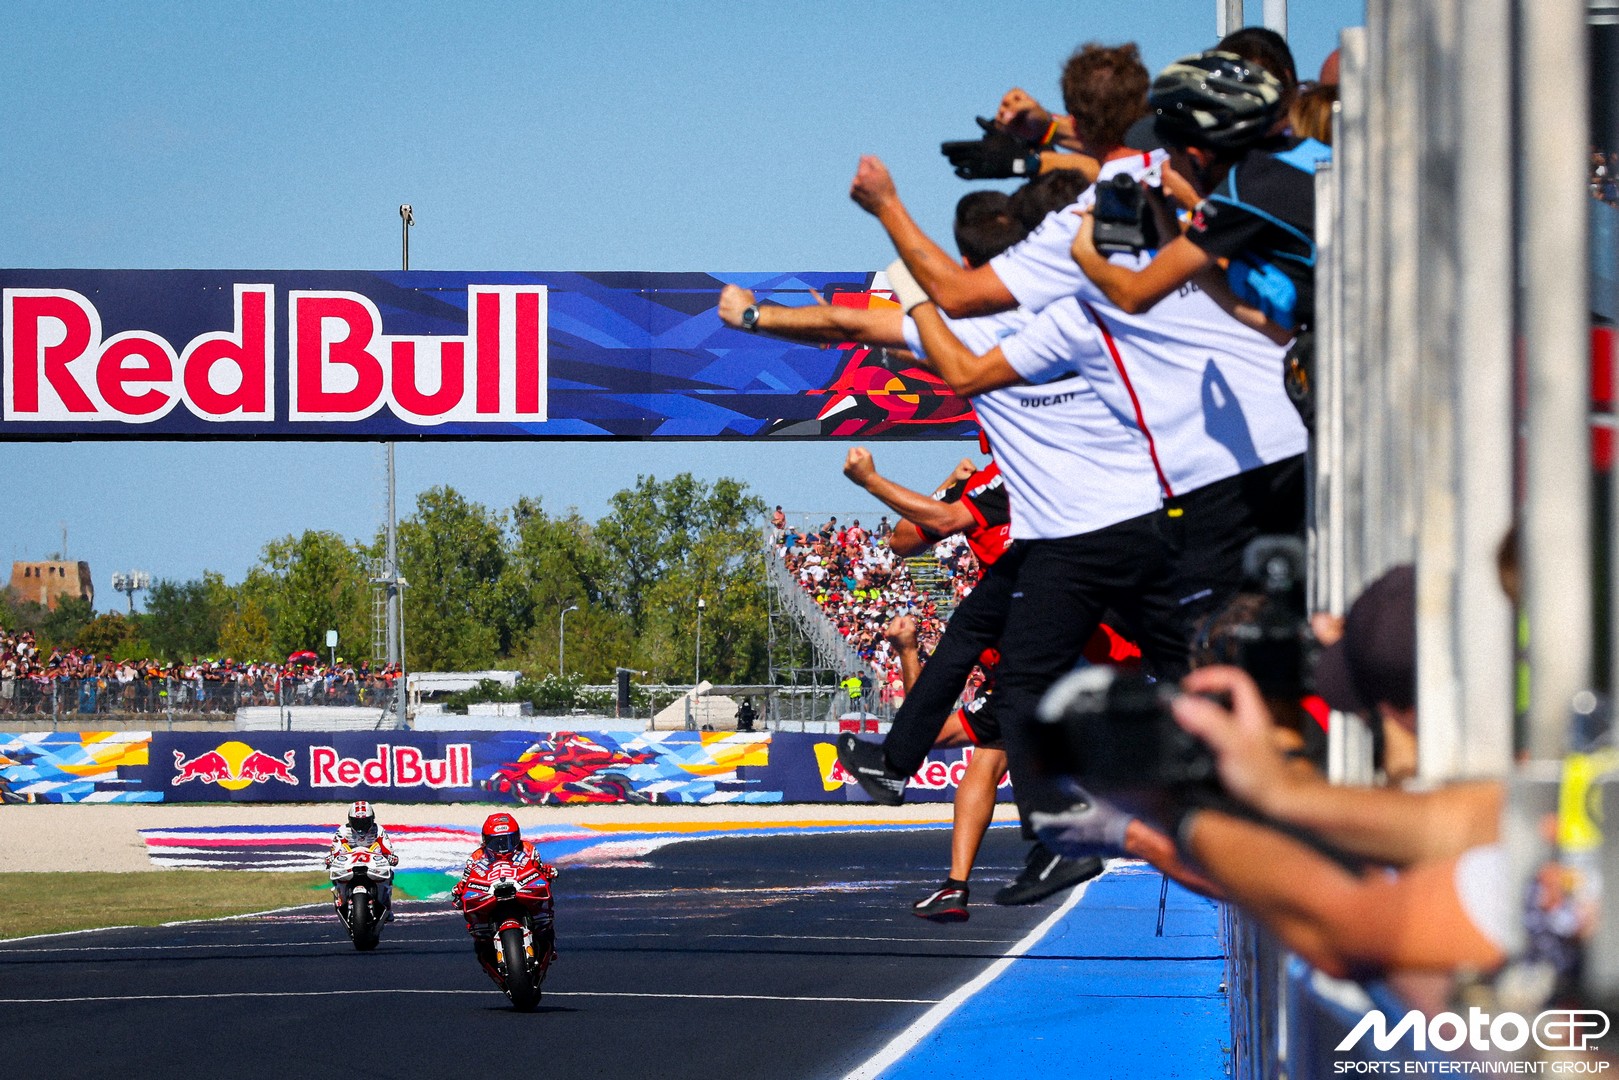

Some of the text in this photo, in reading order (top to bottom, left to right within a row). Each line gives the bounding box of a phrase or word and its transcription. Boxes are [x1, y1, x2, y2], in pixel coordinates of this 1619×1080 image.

[4, 284, 548, 426] Red Bull
[309, 743, 473, 788] Red Bull
[351, 851, 371, 864] 73
[519, 872, 539, 886] Lenovo
[467, 882, 489, 892] Lenovo
